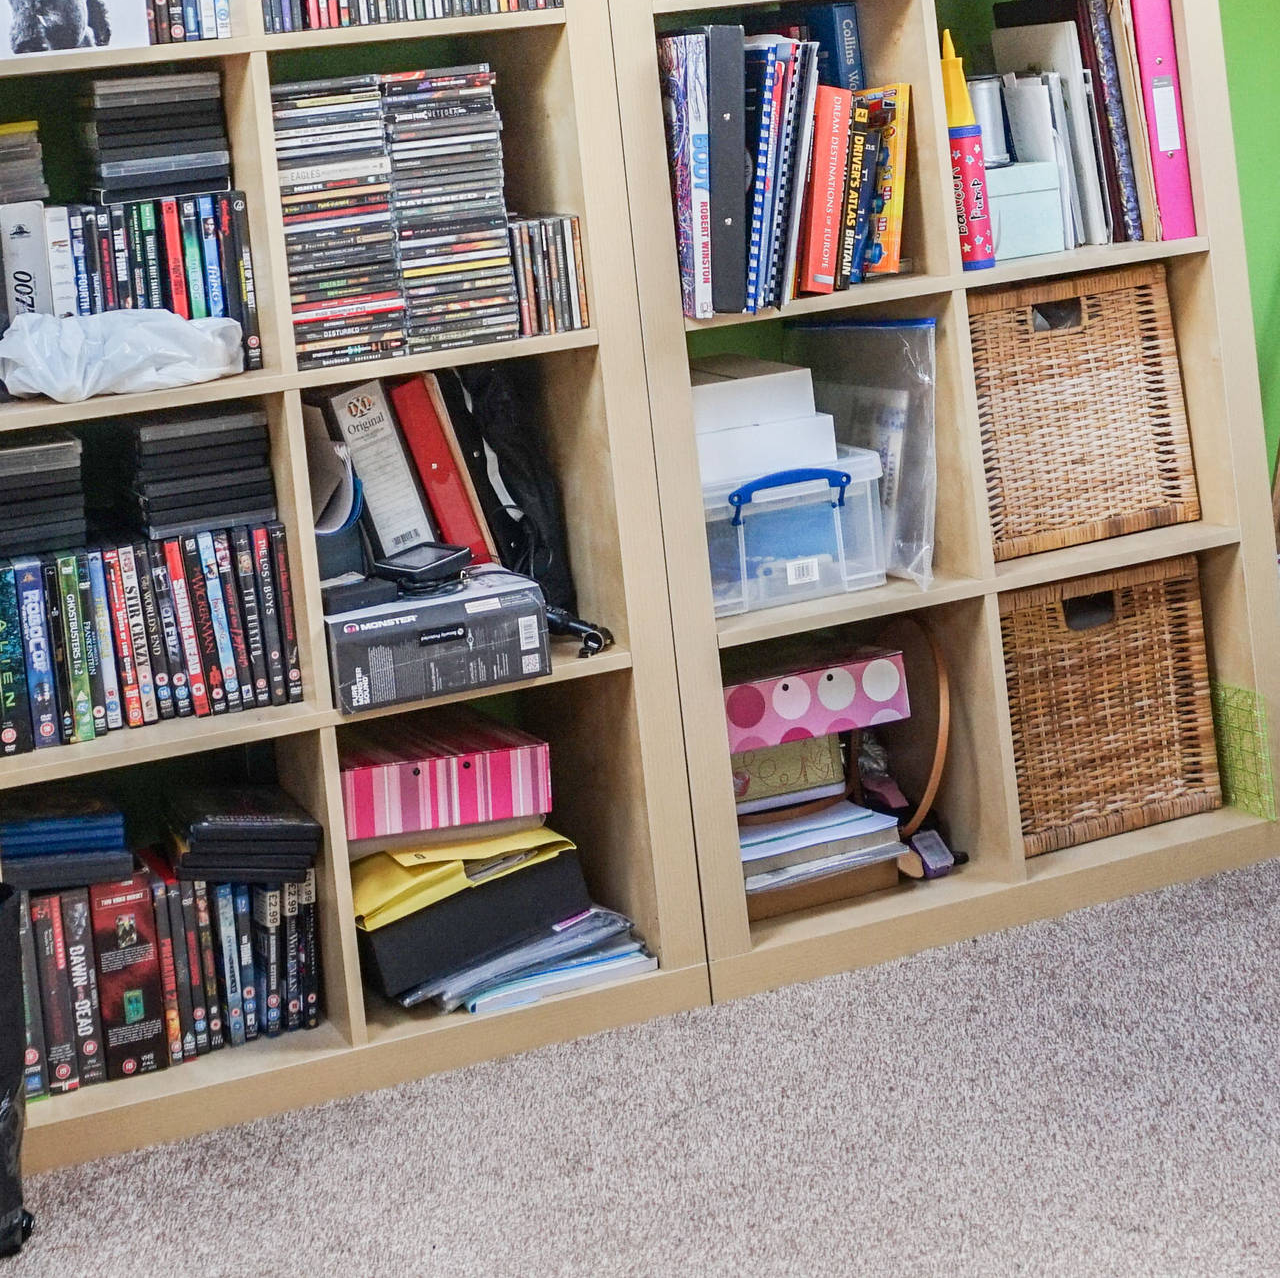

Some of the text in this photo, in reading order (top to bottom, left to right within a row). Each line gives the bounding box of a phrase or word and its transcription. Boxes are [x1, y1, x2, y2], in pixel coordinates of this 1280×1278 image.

[841, 18, 855, 66] Collins
[828, 96, 844, 133] DREAM
[290, 170, 321, 181] EAGLES
[692, 133, 710, 191] BODY
[825, 136, 840, 213] DESTINATIONS
[840, 135, 866, 276] DRIVER'S ATLAS BRITAIN
[700, 201, 711, 284] ROBERT WINSTON
[818, 228, 833, 268] EUROPE
[13, 270, 35, 310] 007
[77, 273, 90, 309] FOURTH
[208, 265, 221, 301] THING
[347, 412, 385, 436] Original
[244, 588, 255, 608] THE
[258, 539, 275, 616] THE LOST BOYS
[66, 594, 81, 658] GHOSTBUSTERS
[84, 620, 97, 676] FRANKENSTEIN
[124, 586, 148, 669] STIR CRAZY
[143, 590, 156, 633] WORLD'S
[151, 634, 160, 656] END
[173, 578, 201, 675] SHAUN DEAD
[360, 614, 418, 631] MONSTER
[269, 893, 279, 926] £2.99
[287, 883, 297, 914] £2.99
[69, 944, 94, 1036] DAWN DEAD
[288, 936, 298, 994] WOLFMAN
